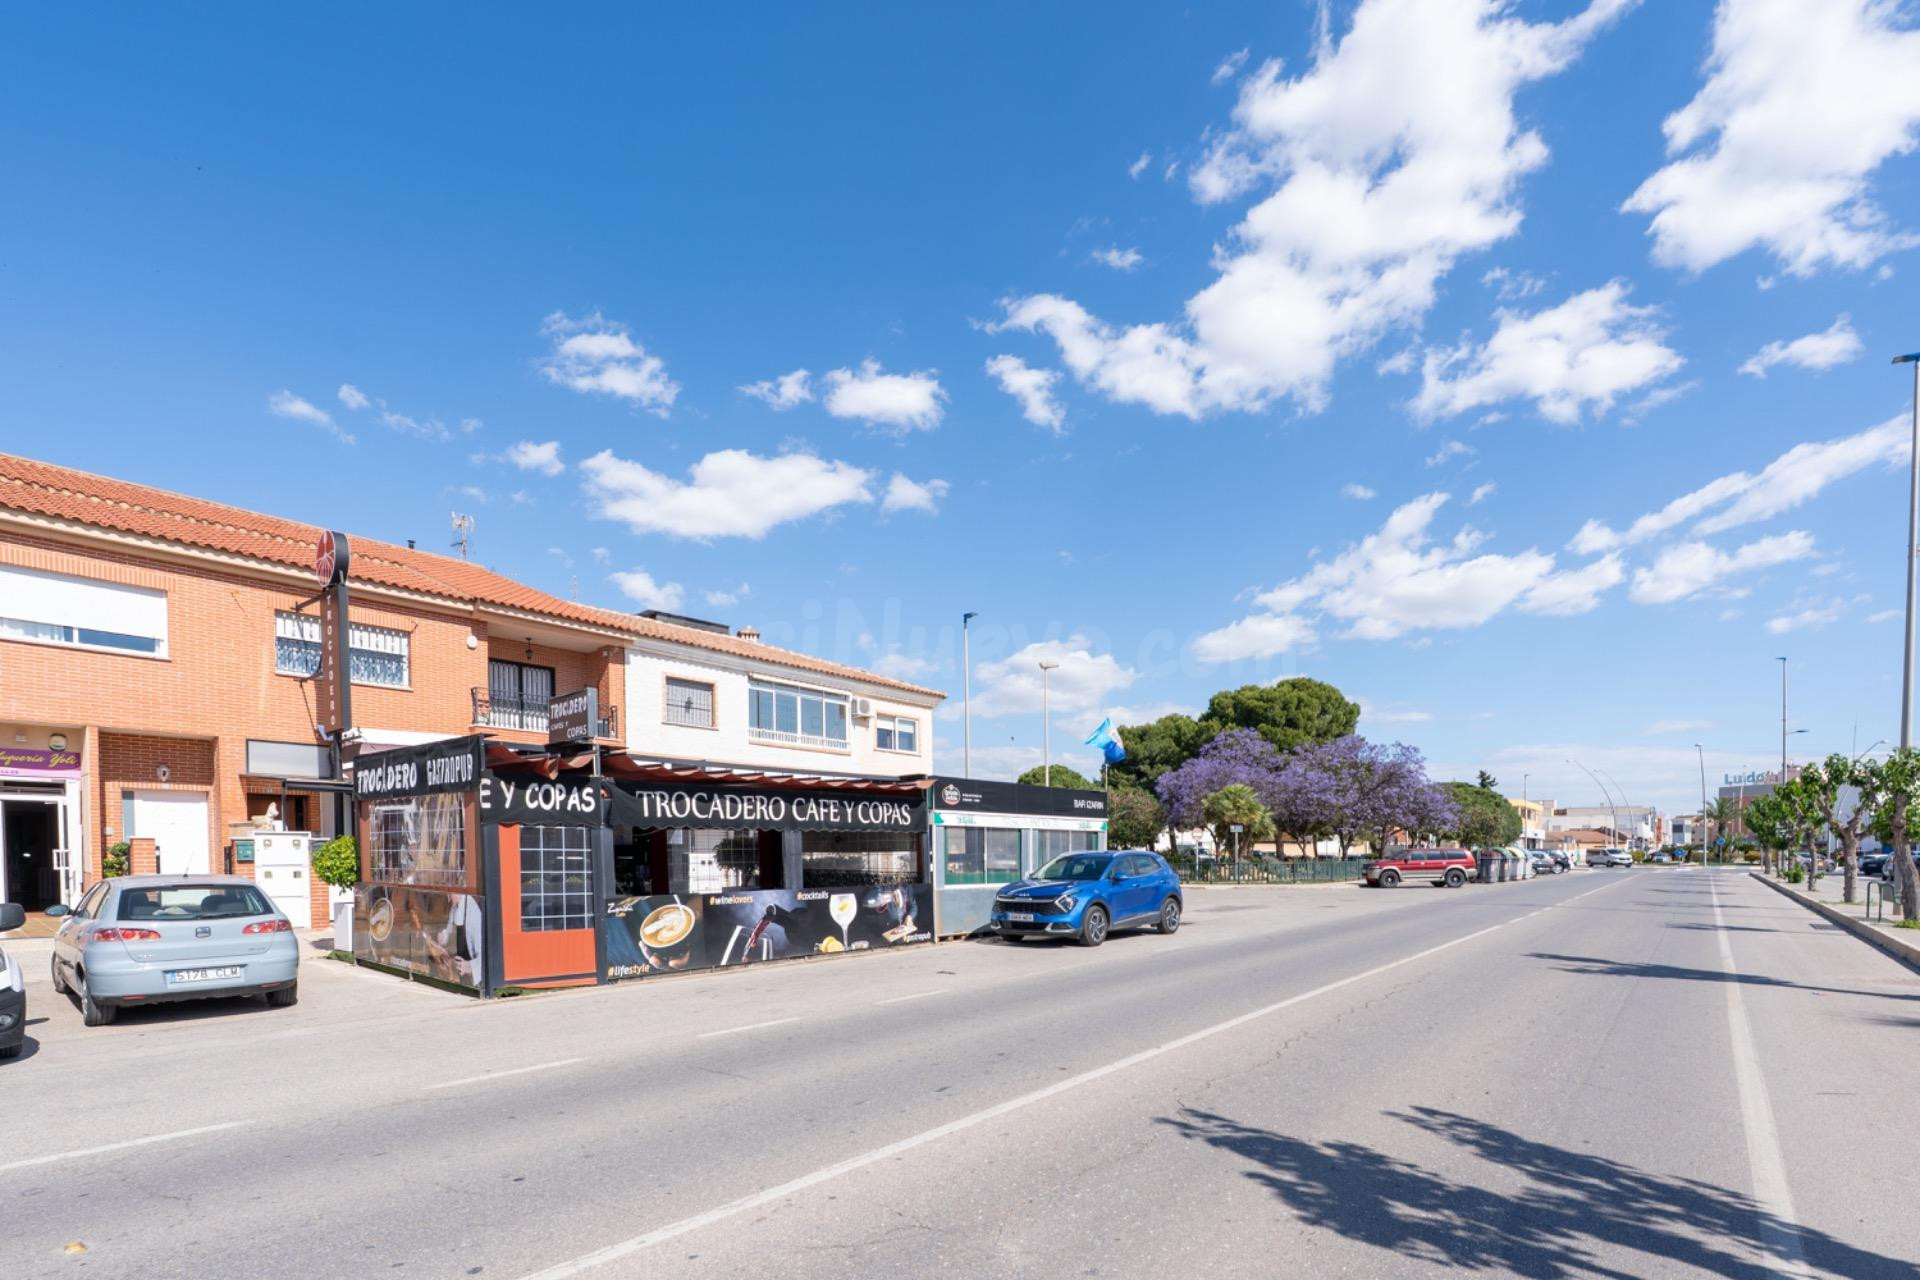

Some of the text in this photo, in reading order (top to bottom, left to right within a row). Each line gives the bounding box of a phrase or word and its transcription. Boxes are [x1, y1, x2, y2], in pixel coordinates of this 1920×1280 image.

[325, 593, 337, 726] TROCADERO
[567, 724, 587, 738] COPAS
[426, 753, 474, 786] GASTROPUB
[480, 777, 596, 813] E Y COPAS
[635, 790, 912, 826] TROCADERO CAFE Y COPAS
[1073, 799, 1086, 809] BAR
[709, 895, 754, 906] #winelovers
[797, 890, 829, 901] #cocktails
[608, 963, 651, 977] #lifestyle
